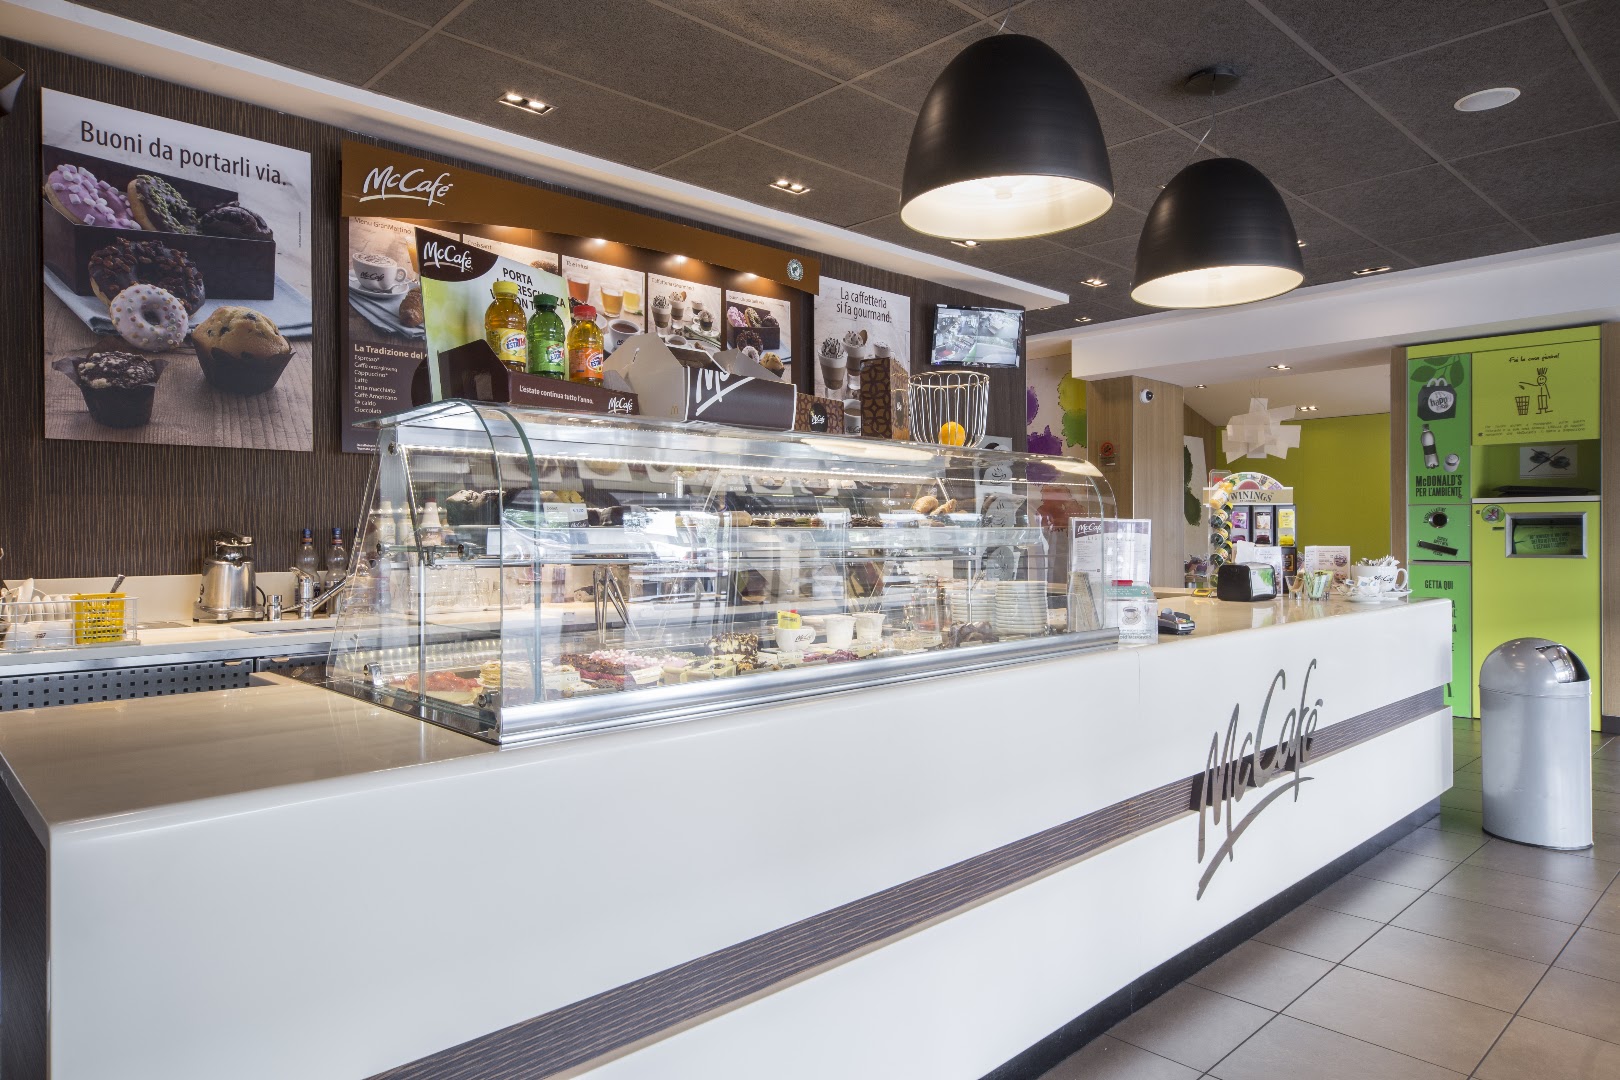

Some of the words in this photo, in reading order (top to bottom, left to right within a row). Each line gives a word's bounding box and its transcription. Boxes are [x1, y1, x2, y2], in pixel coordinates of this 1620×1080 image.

[81, 120, 142, 154] Buoni
[149, 137, 173, 161] da
[180, 147, 250, 178] portarli
[255, 163, 287, 186] via.
[360, 165, 454, 207] McCafé
[423, 241, 474, 273] McCafé
[502, 267, 533, 286] PORTA
[841, 286, 849, 301] La
[850, 290, 887, 309] caffetteria
[836, 300, 843, 313] si
[844, 301, 852, 315] fa
[354, 343, 364, 352] La
[366, 345, 409, 358] Tradizione
[410, 351, 423, 360] del
[519, 384, 541, 396] L'estate
[540, 389, 564, 400] continua
[564, 393, 577, 402] tutto
[607, 396, 633, 414] McCafé
[1415, 487, 1427, 497] PER
[1428, 486, 1462, 497] L'AMBIENTE
[1424, 579, 1443, 590] GETTA
[1443, 580, 1454, 590] QUI
[1197, 658, 1324, 866] McCafé
